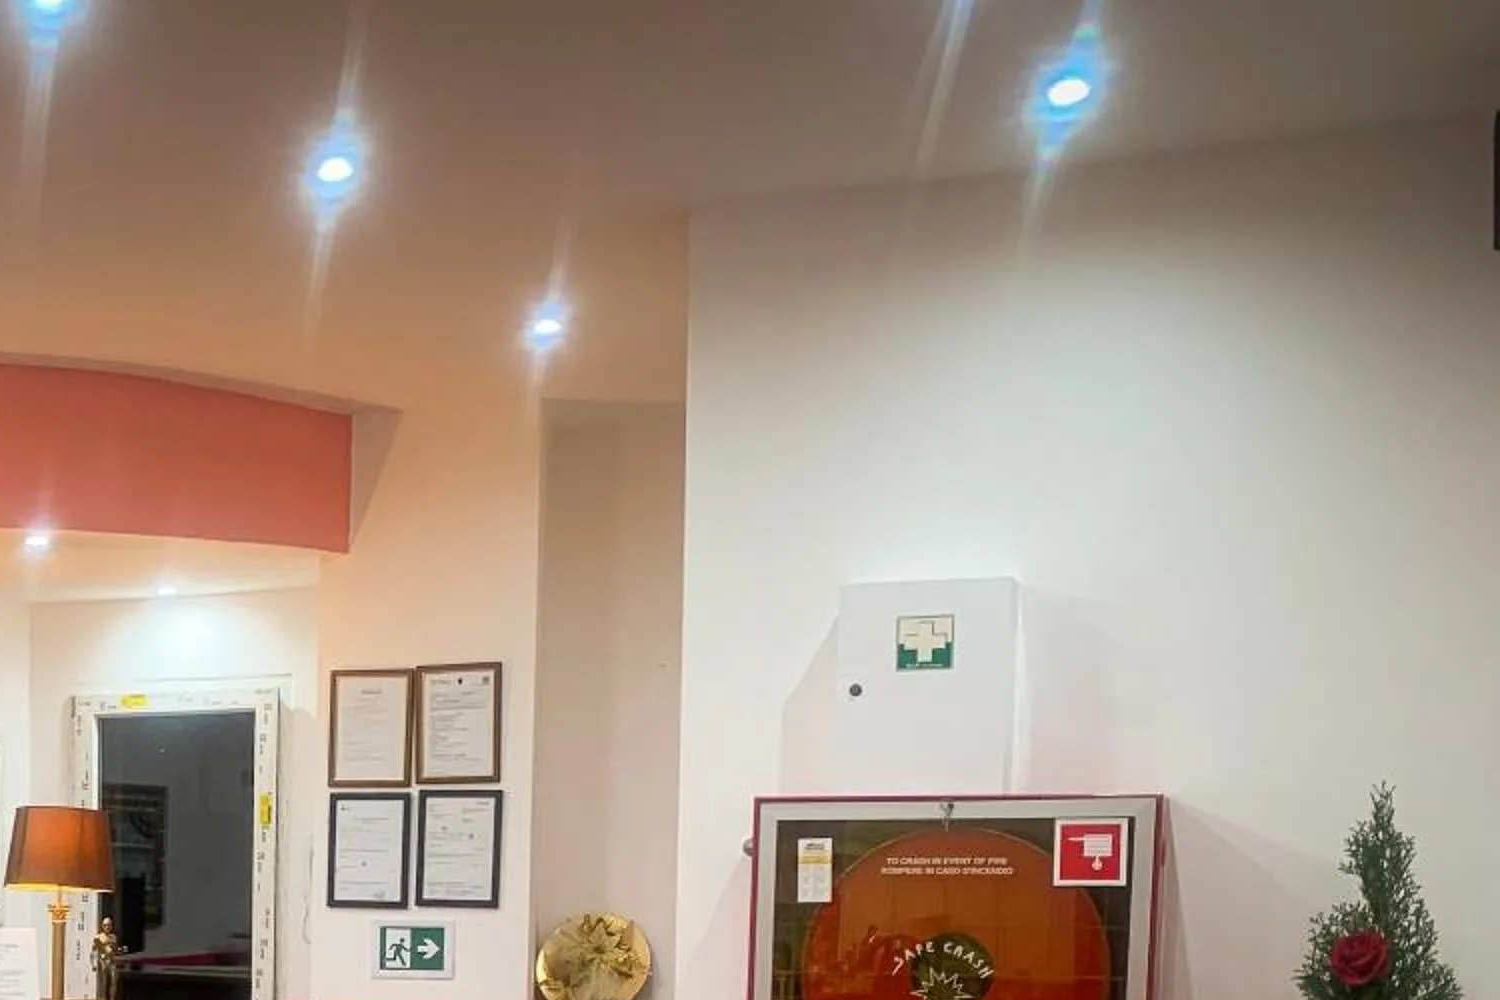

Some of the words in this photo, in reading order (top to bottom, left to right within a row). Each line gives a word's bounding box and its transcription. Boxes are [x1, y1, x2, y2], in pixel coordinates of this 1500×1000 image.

[887, 857, 899, 865] TO
[891, 941, 935, 977] TAPE
[943, 941, 995, 979] CRASH
